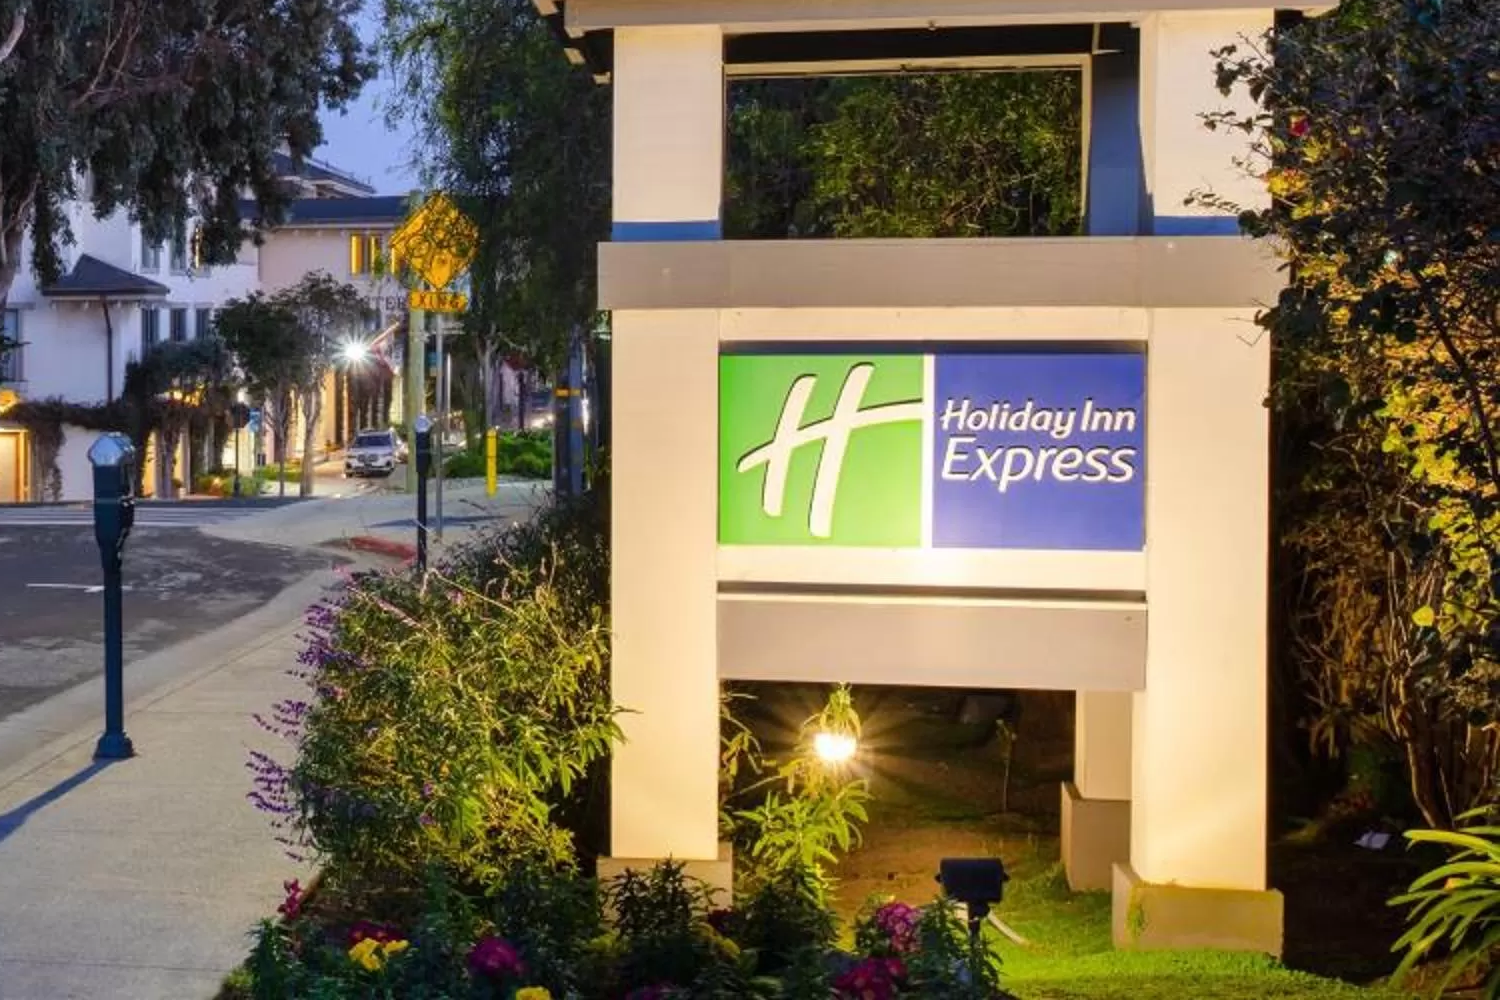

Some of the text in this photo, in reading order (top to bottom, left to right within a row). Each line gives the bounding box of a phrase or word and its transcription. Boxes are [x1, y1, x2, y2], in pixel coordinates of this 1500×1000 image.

[416, 292, 462, 310] XING
[940, 397, 1137, 440] Holiday Inn
[941, 434, 1137, 492] Express
